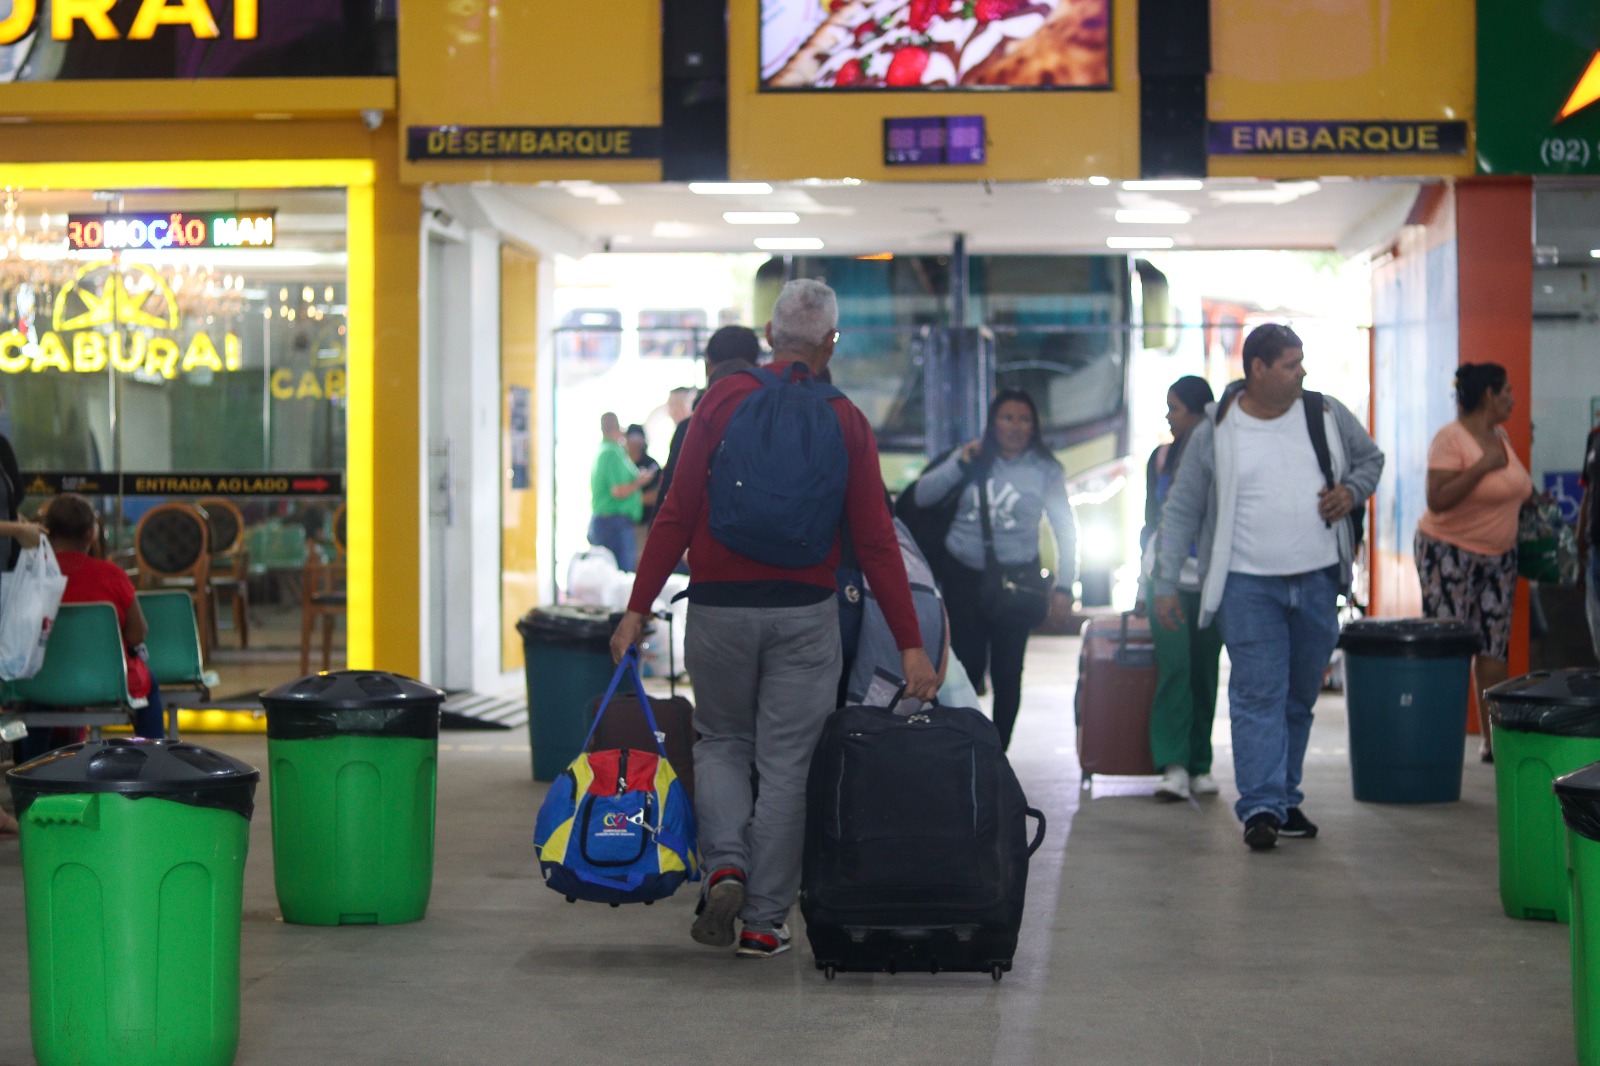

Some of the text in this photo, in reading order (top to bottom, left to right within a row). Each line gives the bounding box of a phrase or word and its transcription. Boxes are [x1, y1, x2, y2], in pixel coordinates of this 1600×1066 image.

[427, 131, 632, 154] DESEMBARQUE
[1231, 126, 1440, 150] EMBARQUE
[1540, 138, 1590, 167] (92)
[0, 331, 240, 379] CABURAI
[135, 477, 213, 492] ENTRADA
